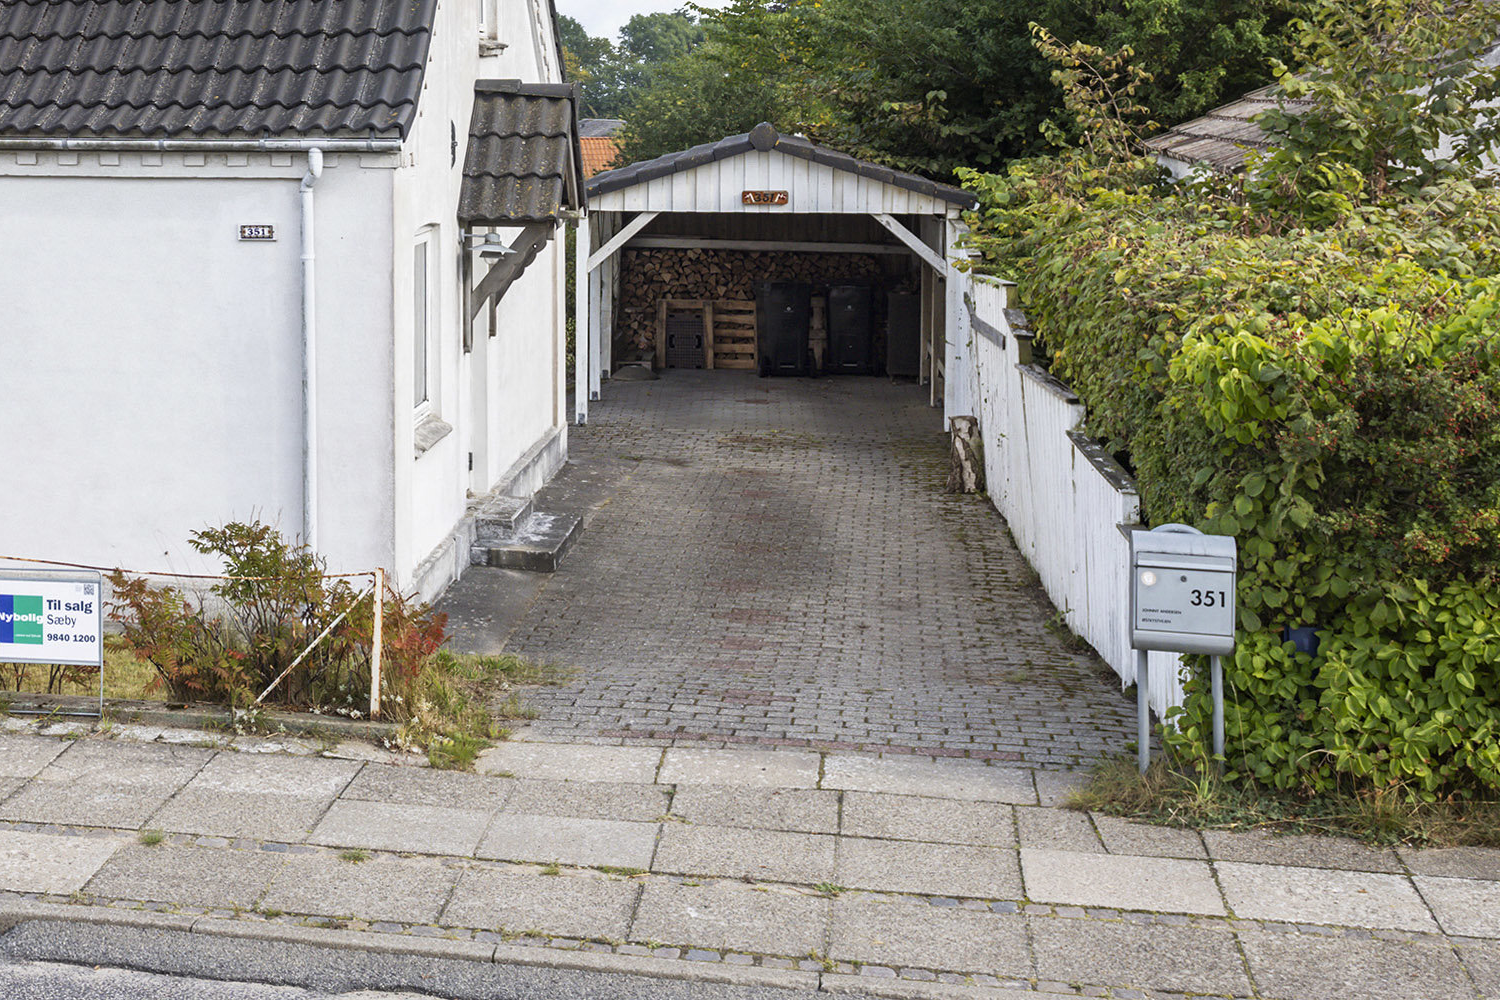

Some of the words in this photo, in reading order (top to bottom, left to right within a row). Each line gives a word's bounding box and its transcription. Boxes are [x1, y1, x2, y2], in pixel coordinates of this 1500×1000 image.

[754, 193, 774, 202] 351
[247, 228, 266, 236] 351
[1190, 589, 1226, 608] 351
[46, 599, 61, 611] Til
[65, 601, 93, 614] salg
[47, 614, 77, 628] Sæby
[47, 633, 70, 642] 9840
[73, 634, 96, 643] 1200
